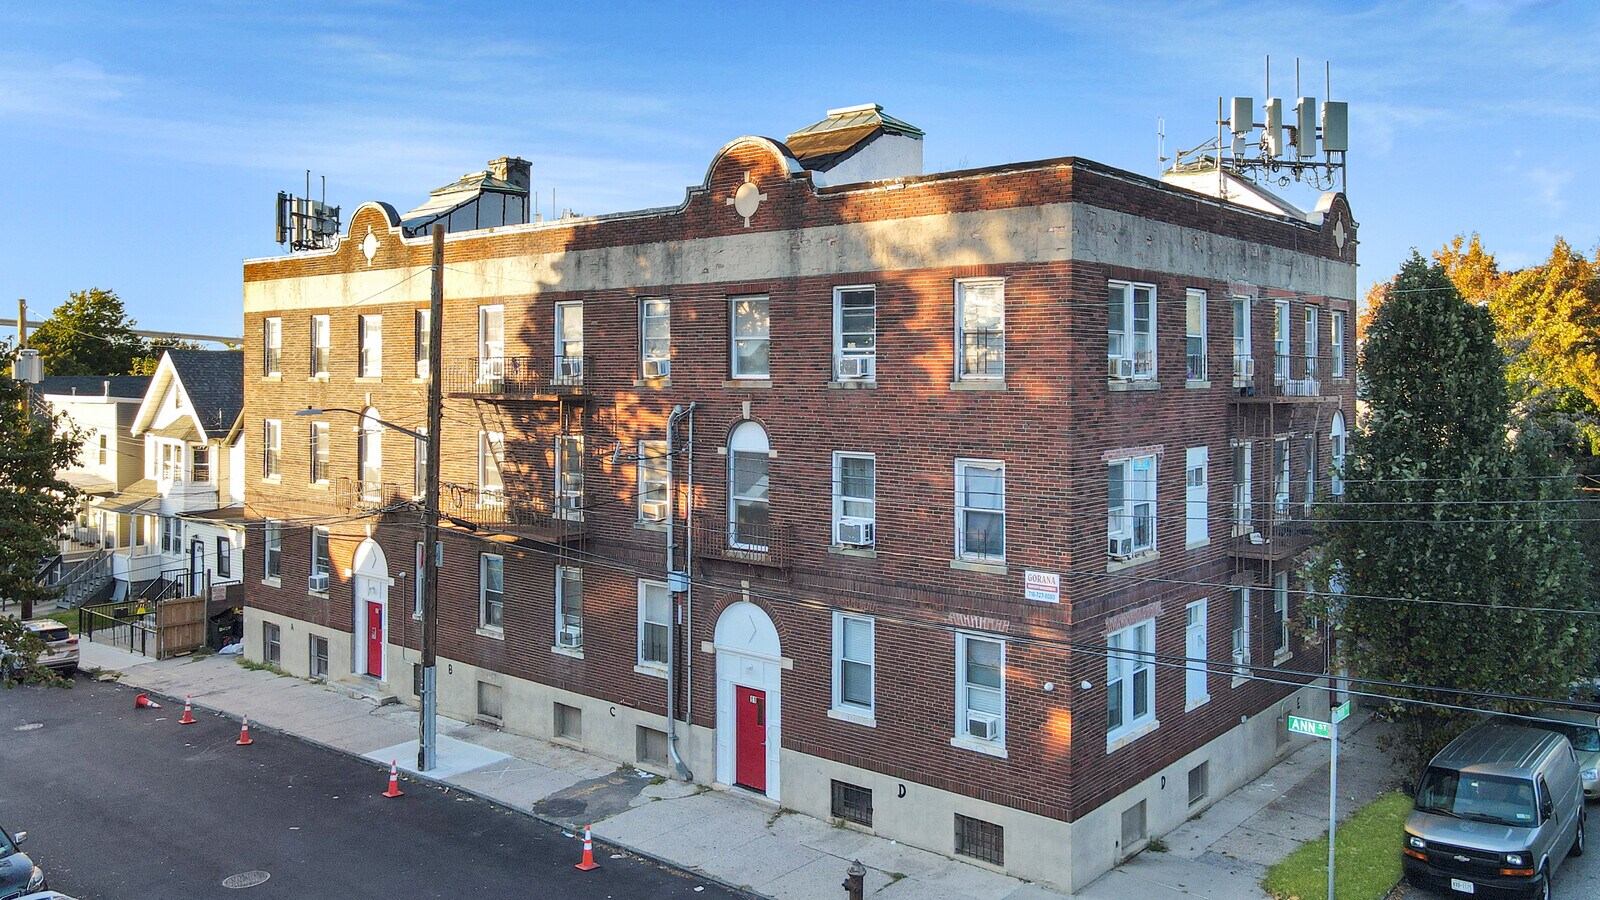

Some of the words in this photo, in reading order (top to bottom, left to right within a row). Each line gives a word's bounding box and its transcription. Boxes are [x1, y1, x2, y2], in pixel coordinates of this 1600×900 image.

[1027, 574, 1056, 585] GORANA
[448, 663, 453, 675] B
[609, 706, 616, 717] C
[1291, 719, 1316, 733] ANN
[1318, 723, 1328, 731] ST
[897, 783, 907, 798] D
